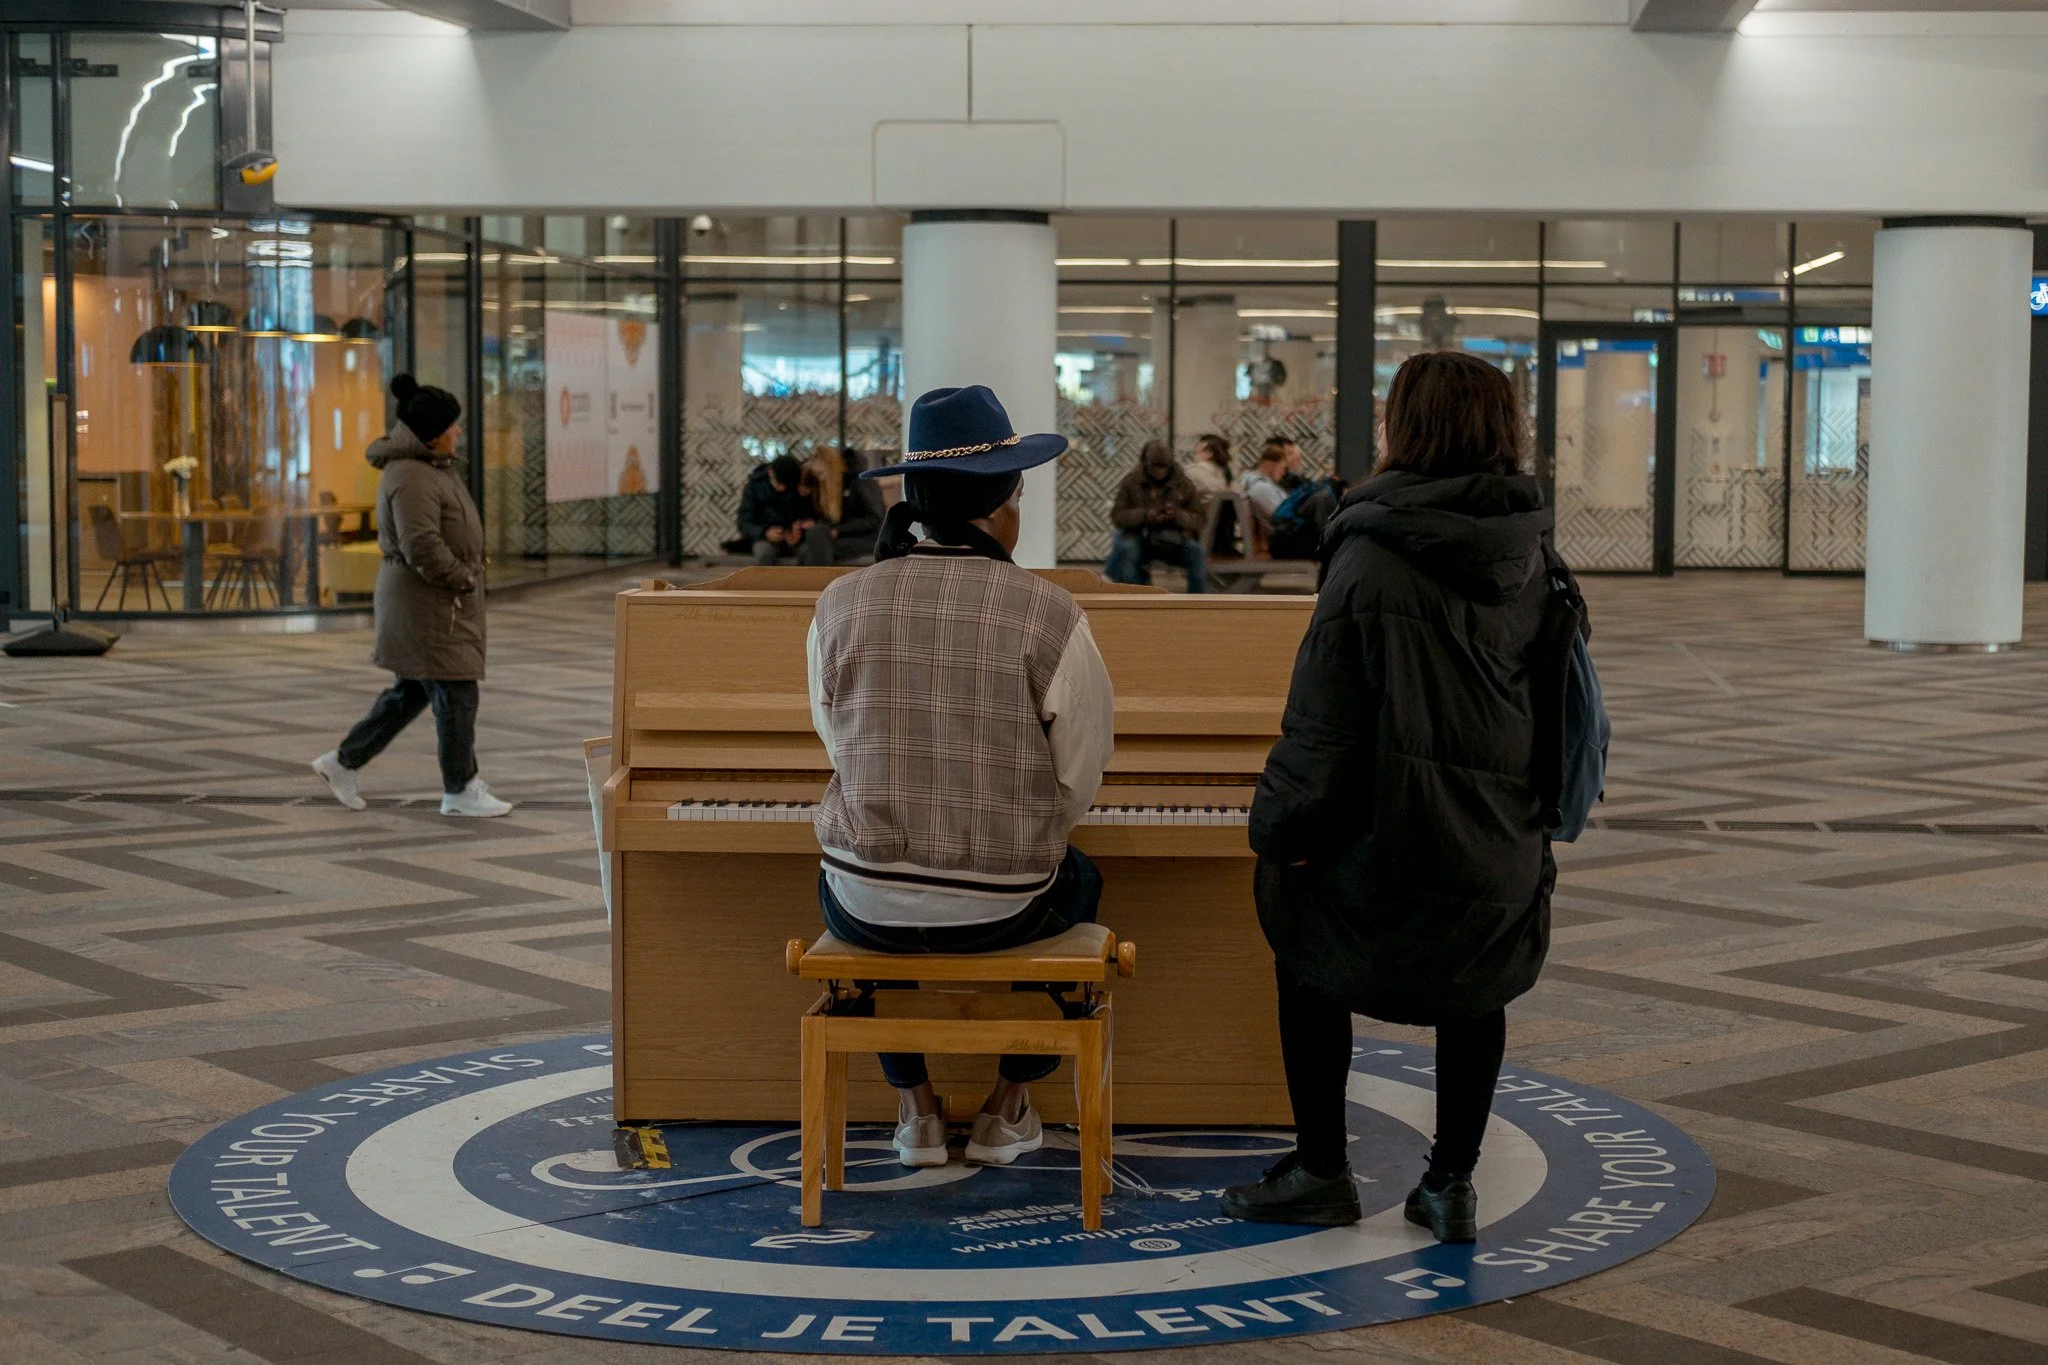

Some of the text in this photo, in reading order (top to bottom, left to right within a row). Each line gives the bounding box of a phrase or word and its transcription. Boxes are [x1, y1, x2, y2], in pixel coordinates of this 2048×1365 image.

[211, 1052, 545, 1256] SHARE YOUR TALENT
[960, 1213, 1070, 1233] Almere
[1472, 1197, 1667, 1274] SHARE
[1583, 1129, 1677, 1190] YOUR
[950, 1216, 1246, 1255] www.mijnstatio
[461, 1283, 1343, 1343] DEEL JE TALENT
